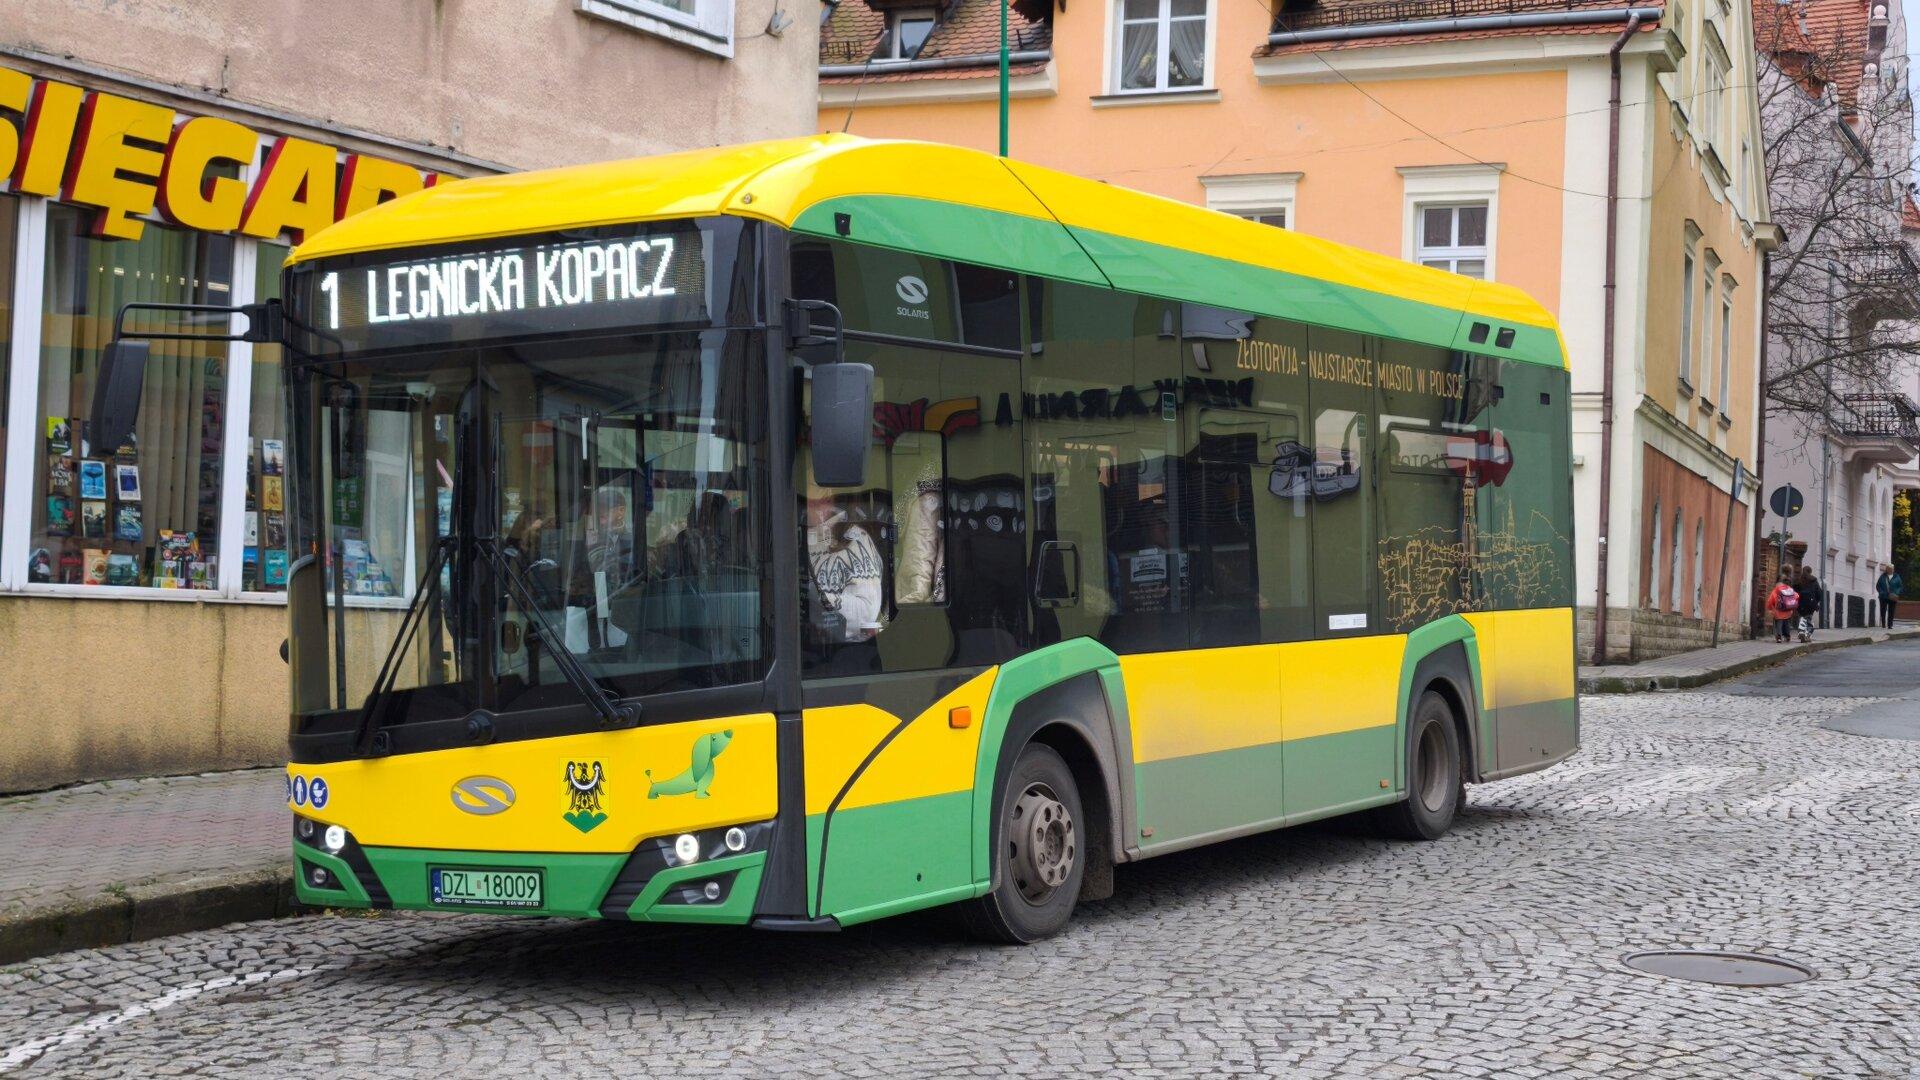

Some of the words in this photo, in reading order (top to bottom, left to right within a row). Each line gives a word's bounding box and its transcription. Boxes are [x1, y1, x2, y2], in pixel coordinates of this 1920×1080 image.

[321, 272, 339, 329] 1
[367, 254, 525, 324] LEGNICKA
[536, 238, 675, 308] KOPACZ
[897, 306, 929, 319] SOLARIS
[1236, 338, 1298, 375] ZŁOTORYJA
[1309, 350, 1372, 387] NAJSTARSZE
[1377, 361, 1412, 393] MIASTO
[1416, 368, 1425, 394] W
[1429, 370, 1463, 399] POLSCE
[442, 873, 476, 896] DZL
[483, 874, 537, 898] 18009
